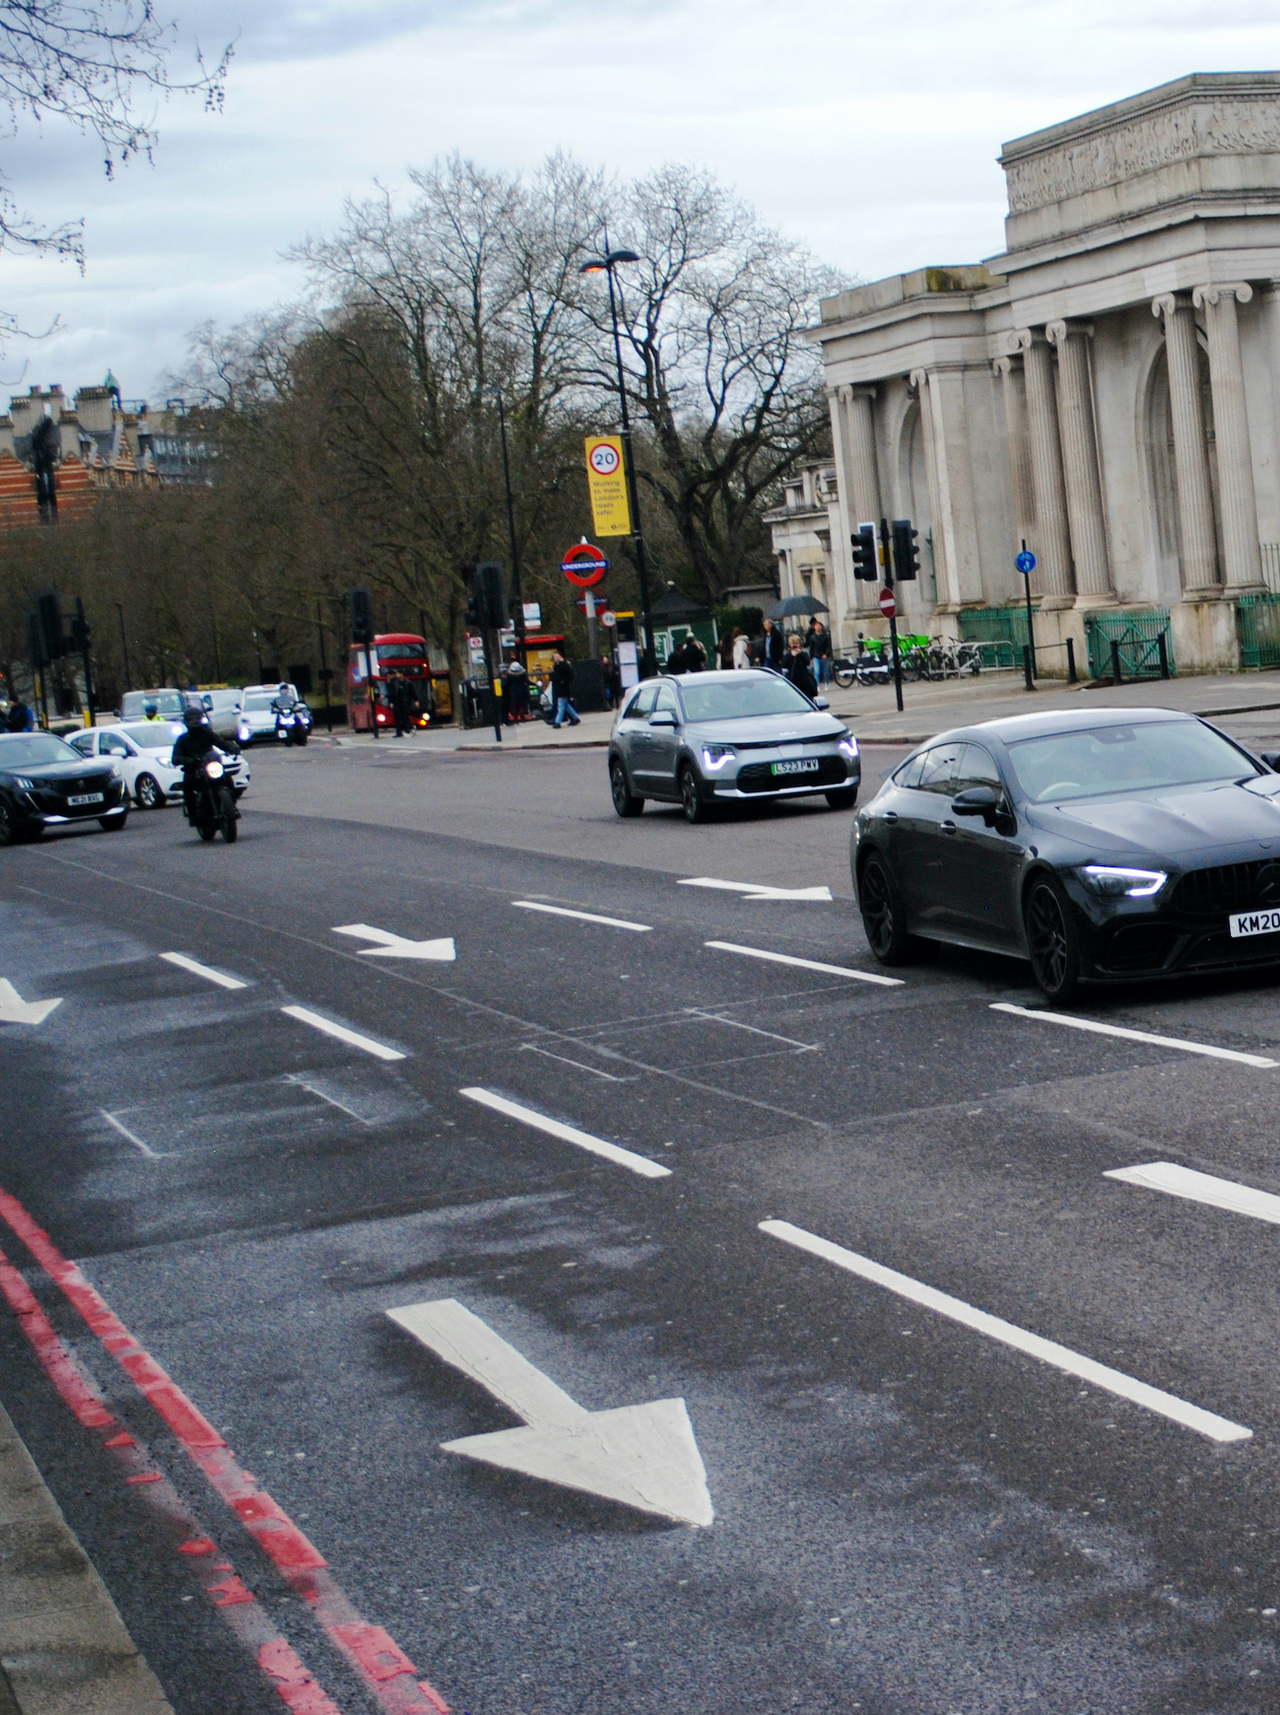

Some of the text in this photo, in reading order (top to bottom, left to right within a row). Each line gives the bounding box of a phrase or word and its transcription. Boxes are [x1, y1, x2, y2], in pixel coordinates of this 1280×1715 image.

[594, 452, 615, 466] 20
[561, 561, 607, 570] UNDERGROUND
[1237, 912, 1280, 934] KM20
